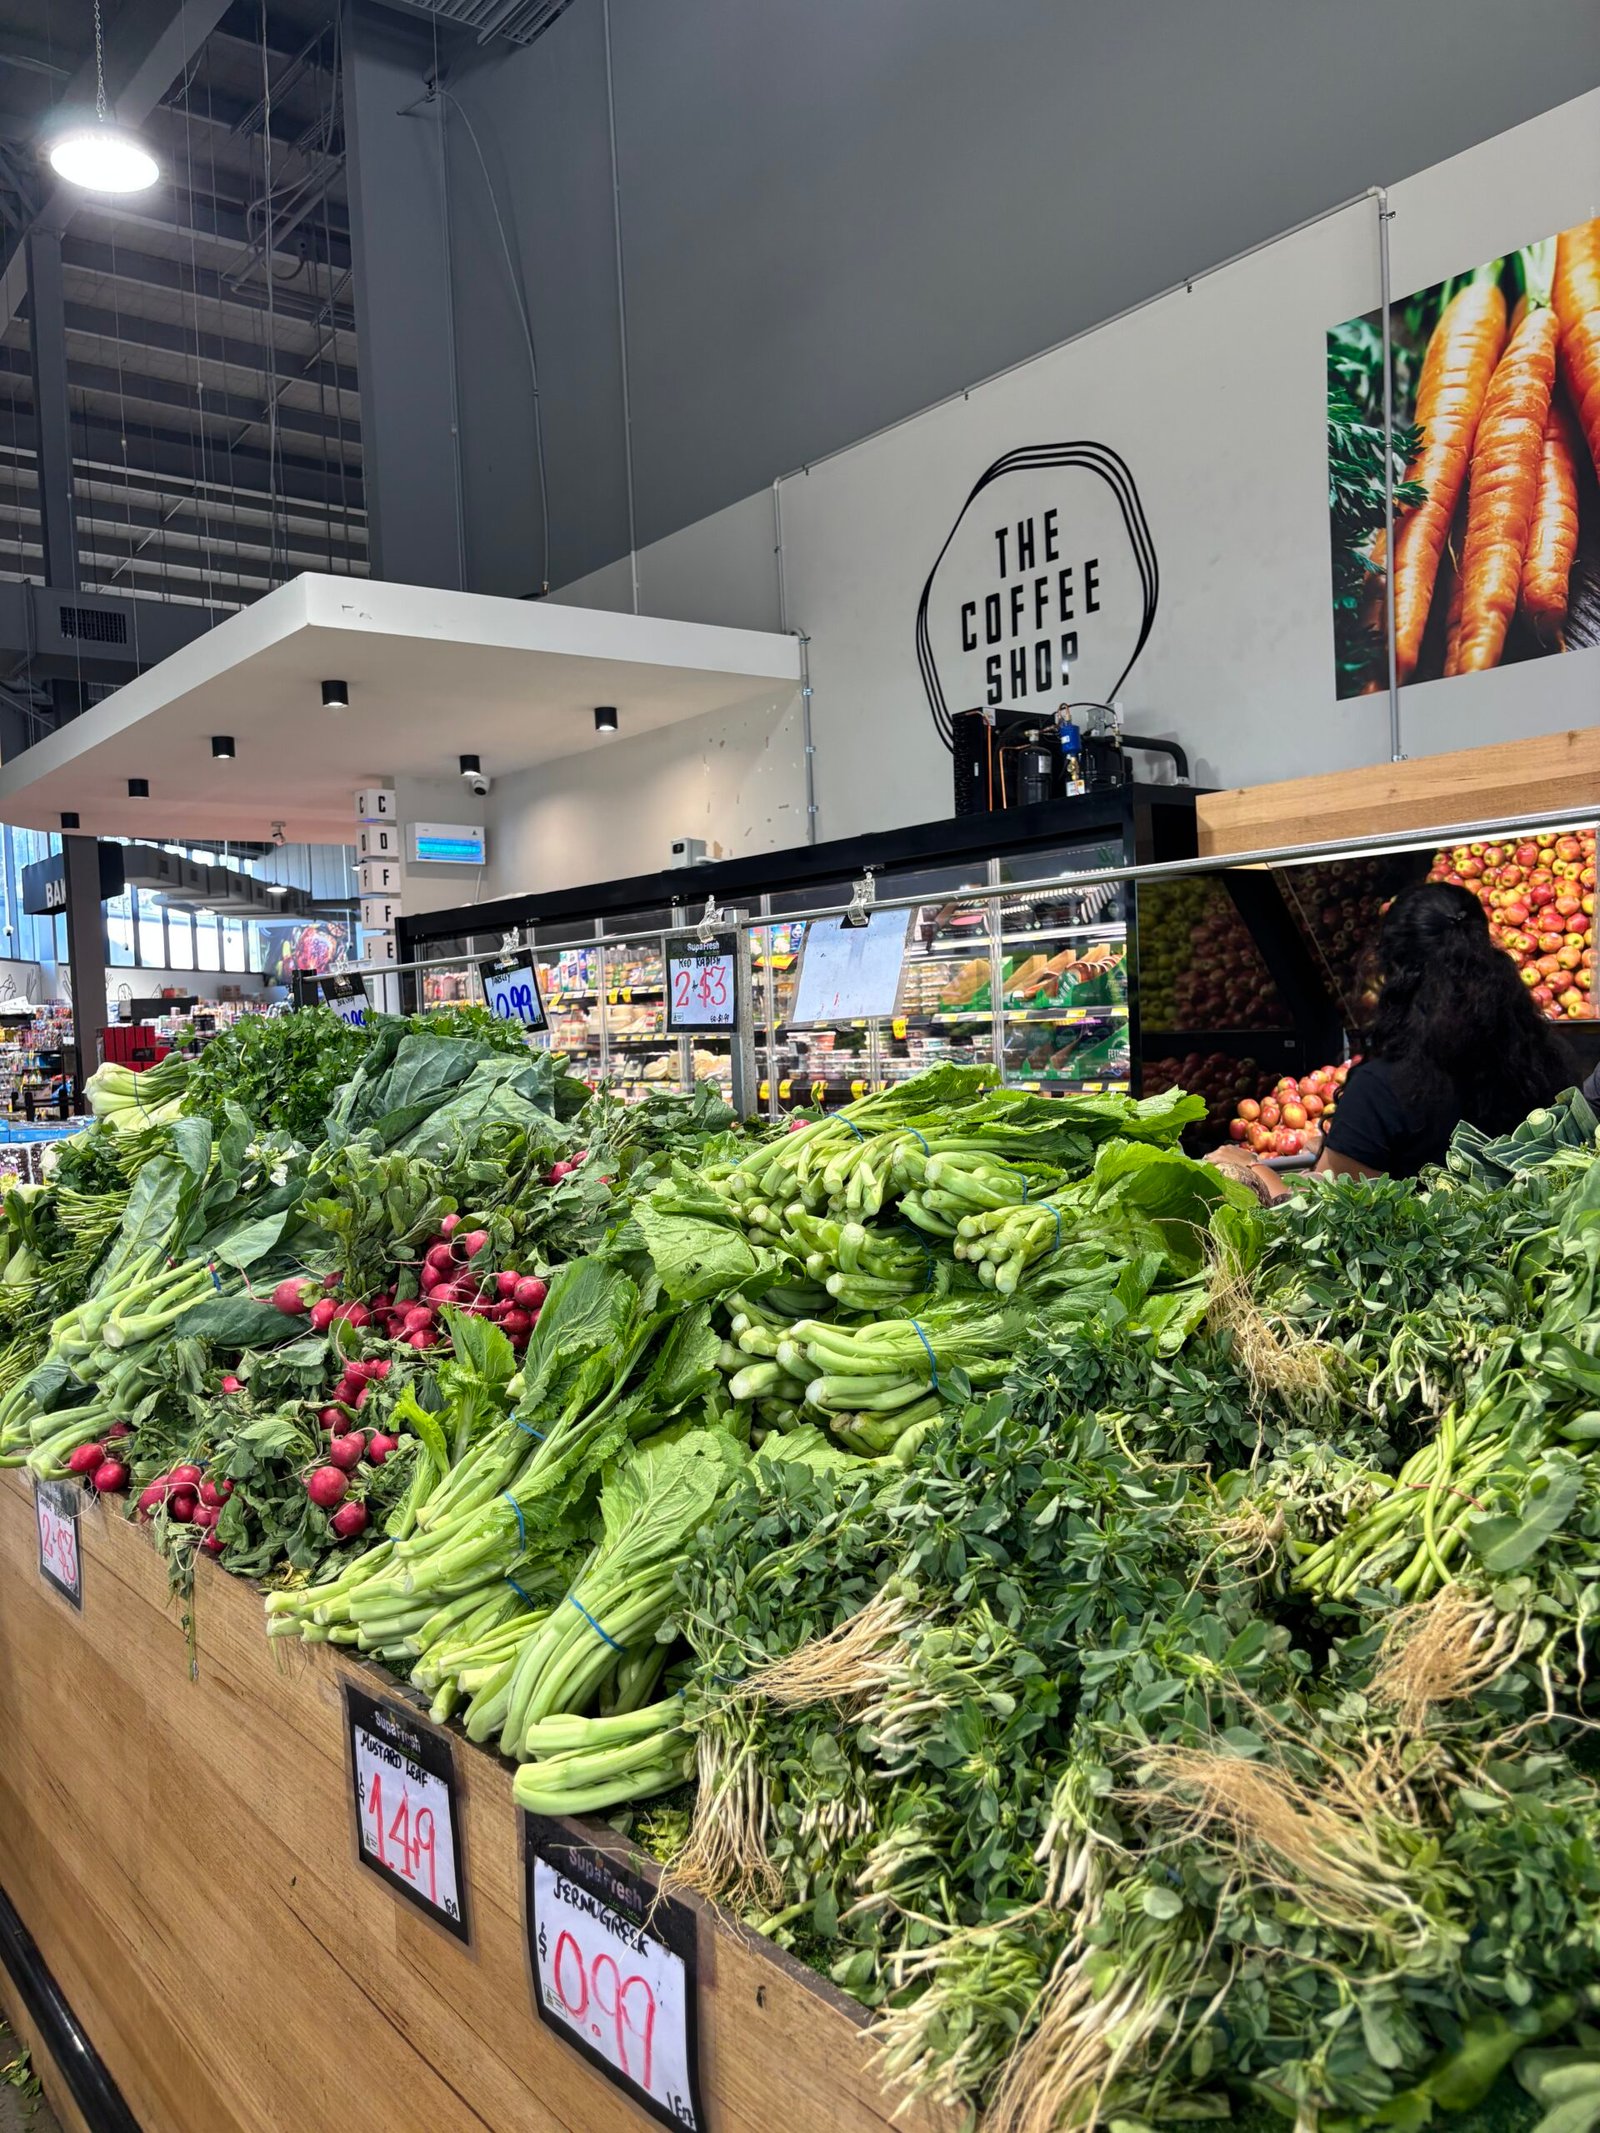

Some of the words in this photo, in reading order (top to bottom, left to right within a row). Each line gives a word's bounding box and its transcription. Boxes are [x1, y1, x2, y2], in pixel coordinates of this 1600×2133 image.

[995, 508, 1059, 578] THE
[961, 558, 1100, 652] COFFEE
[986, 631, 1078, 706] SHOP
[496, 984, 537, 1023] 0.99
[675, 971, 691, 1007] 2
[697, 966, 726, 1008] $3
[42, 1514, 53, 1558] 2
[361, 1733, 402, 1770] MUSTARD
[405, 1759, 429, 1788] LEAF
[374, 1710, 422, 1753] SupaFresh
[368, 1772, 438, 1904] 1.49
[569, 1848, 642, 1911] SupaFresh
[539, 1922, 548, 1962] $
[554, 1929, 656, 2090] 0.99
